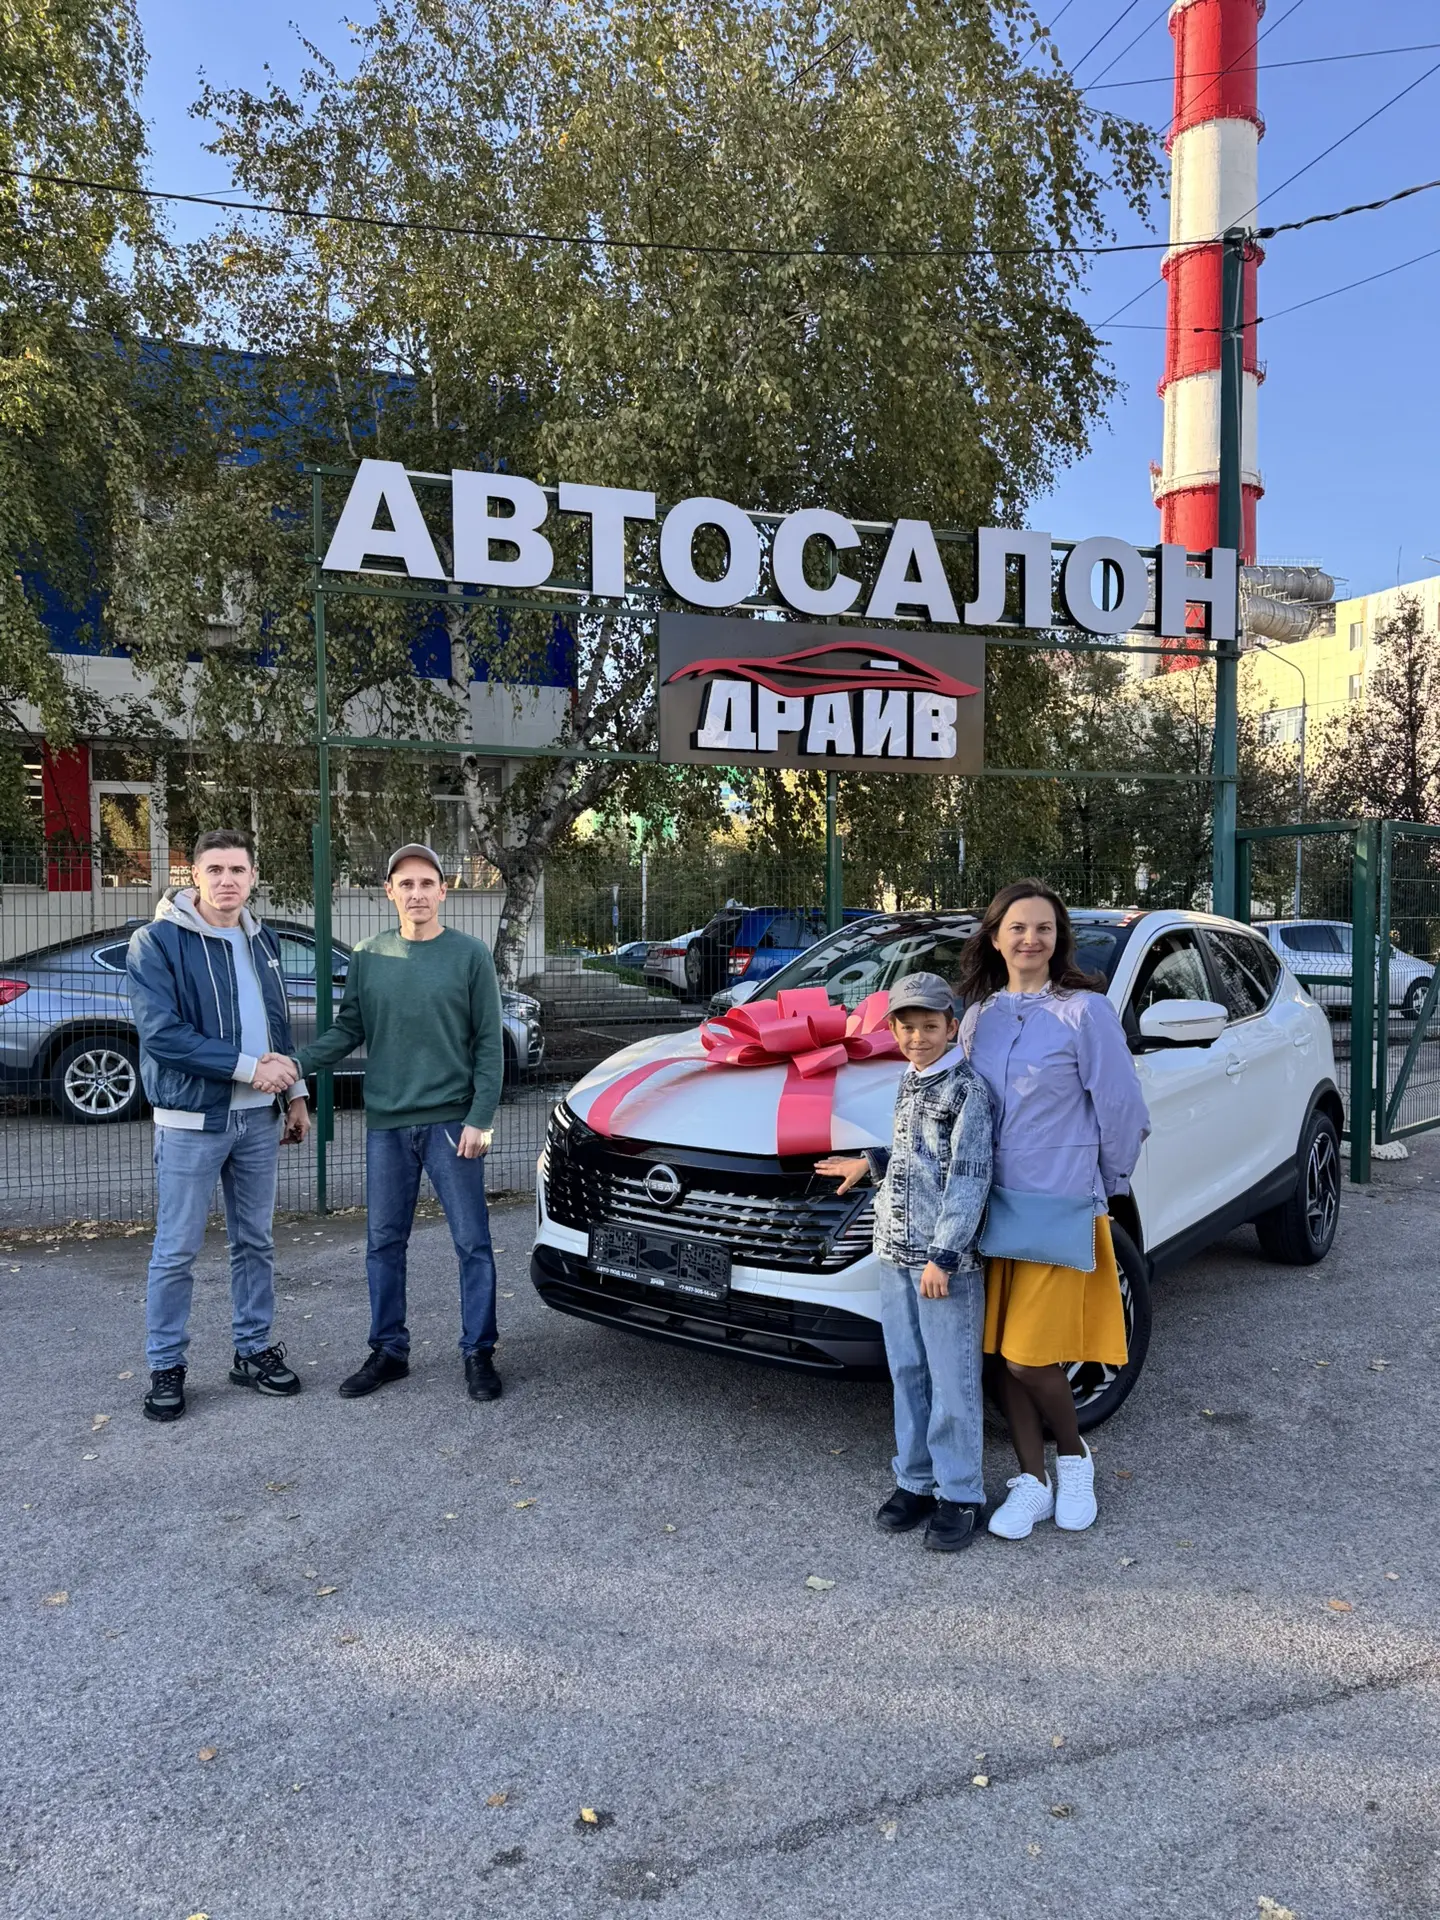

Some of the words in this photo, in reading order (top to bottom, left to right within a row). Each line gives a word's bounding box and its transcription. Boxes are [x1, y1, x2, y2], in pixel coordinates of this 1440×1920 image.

[323, 459, 1239, 640] АВТОСАЛОН
[697, 660, 957, 759] ДРАЙВ
[643, 1178, 681, 1192] NISSAN
